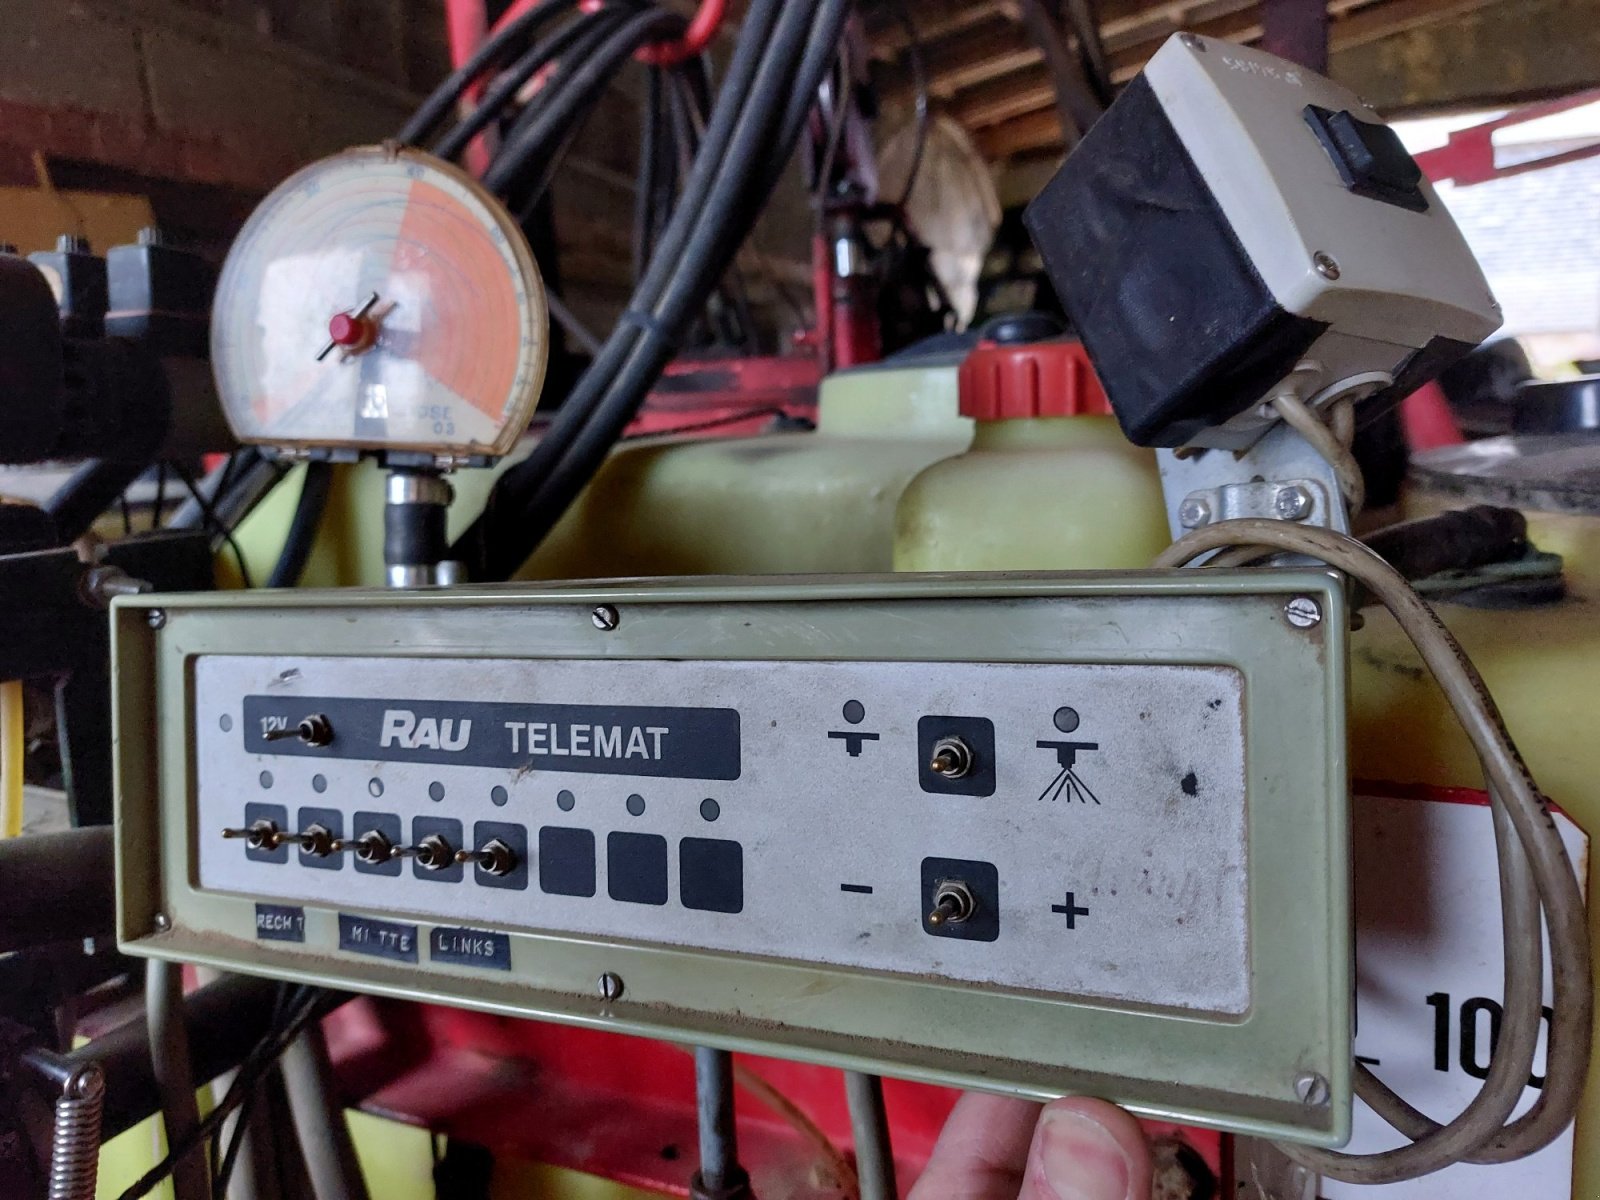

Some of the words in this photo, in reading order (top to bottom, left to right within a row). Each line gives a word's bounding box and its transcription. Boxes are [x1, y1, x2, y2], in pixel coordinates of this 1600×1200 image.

[260, 716, 289, 735] 12V
[379, 709, 472, 751] RAU
[505, 721, 669, 760] TELEMAT
[438, 934, 495, 957] LINKS
